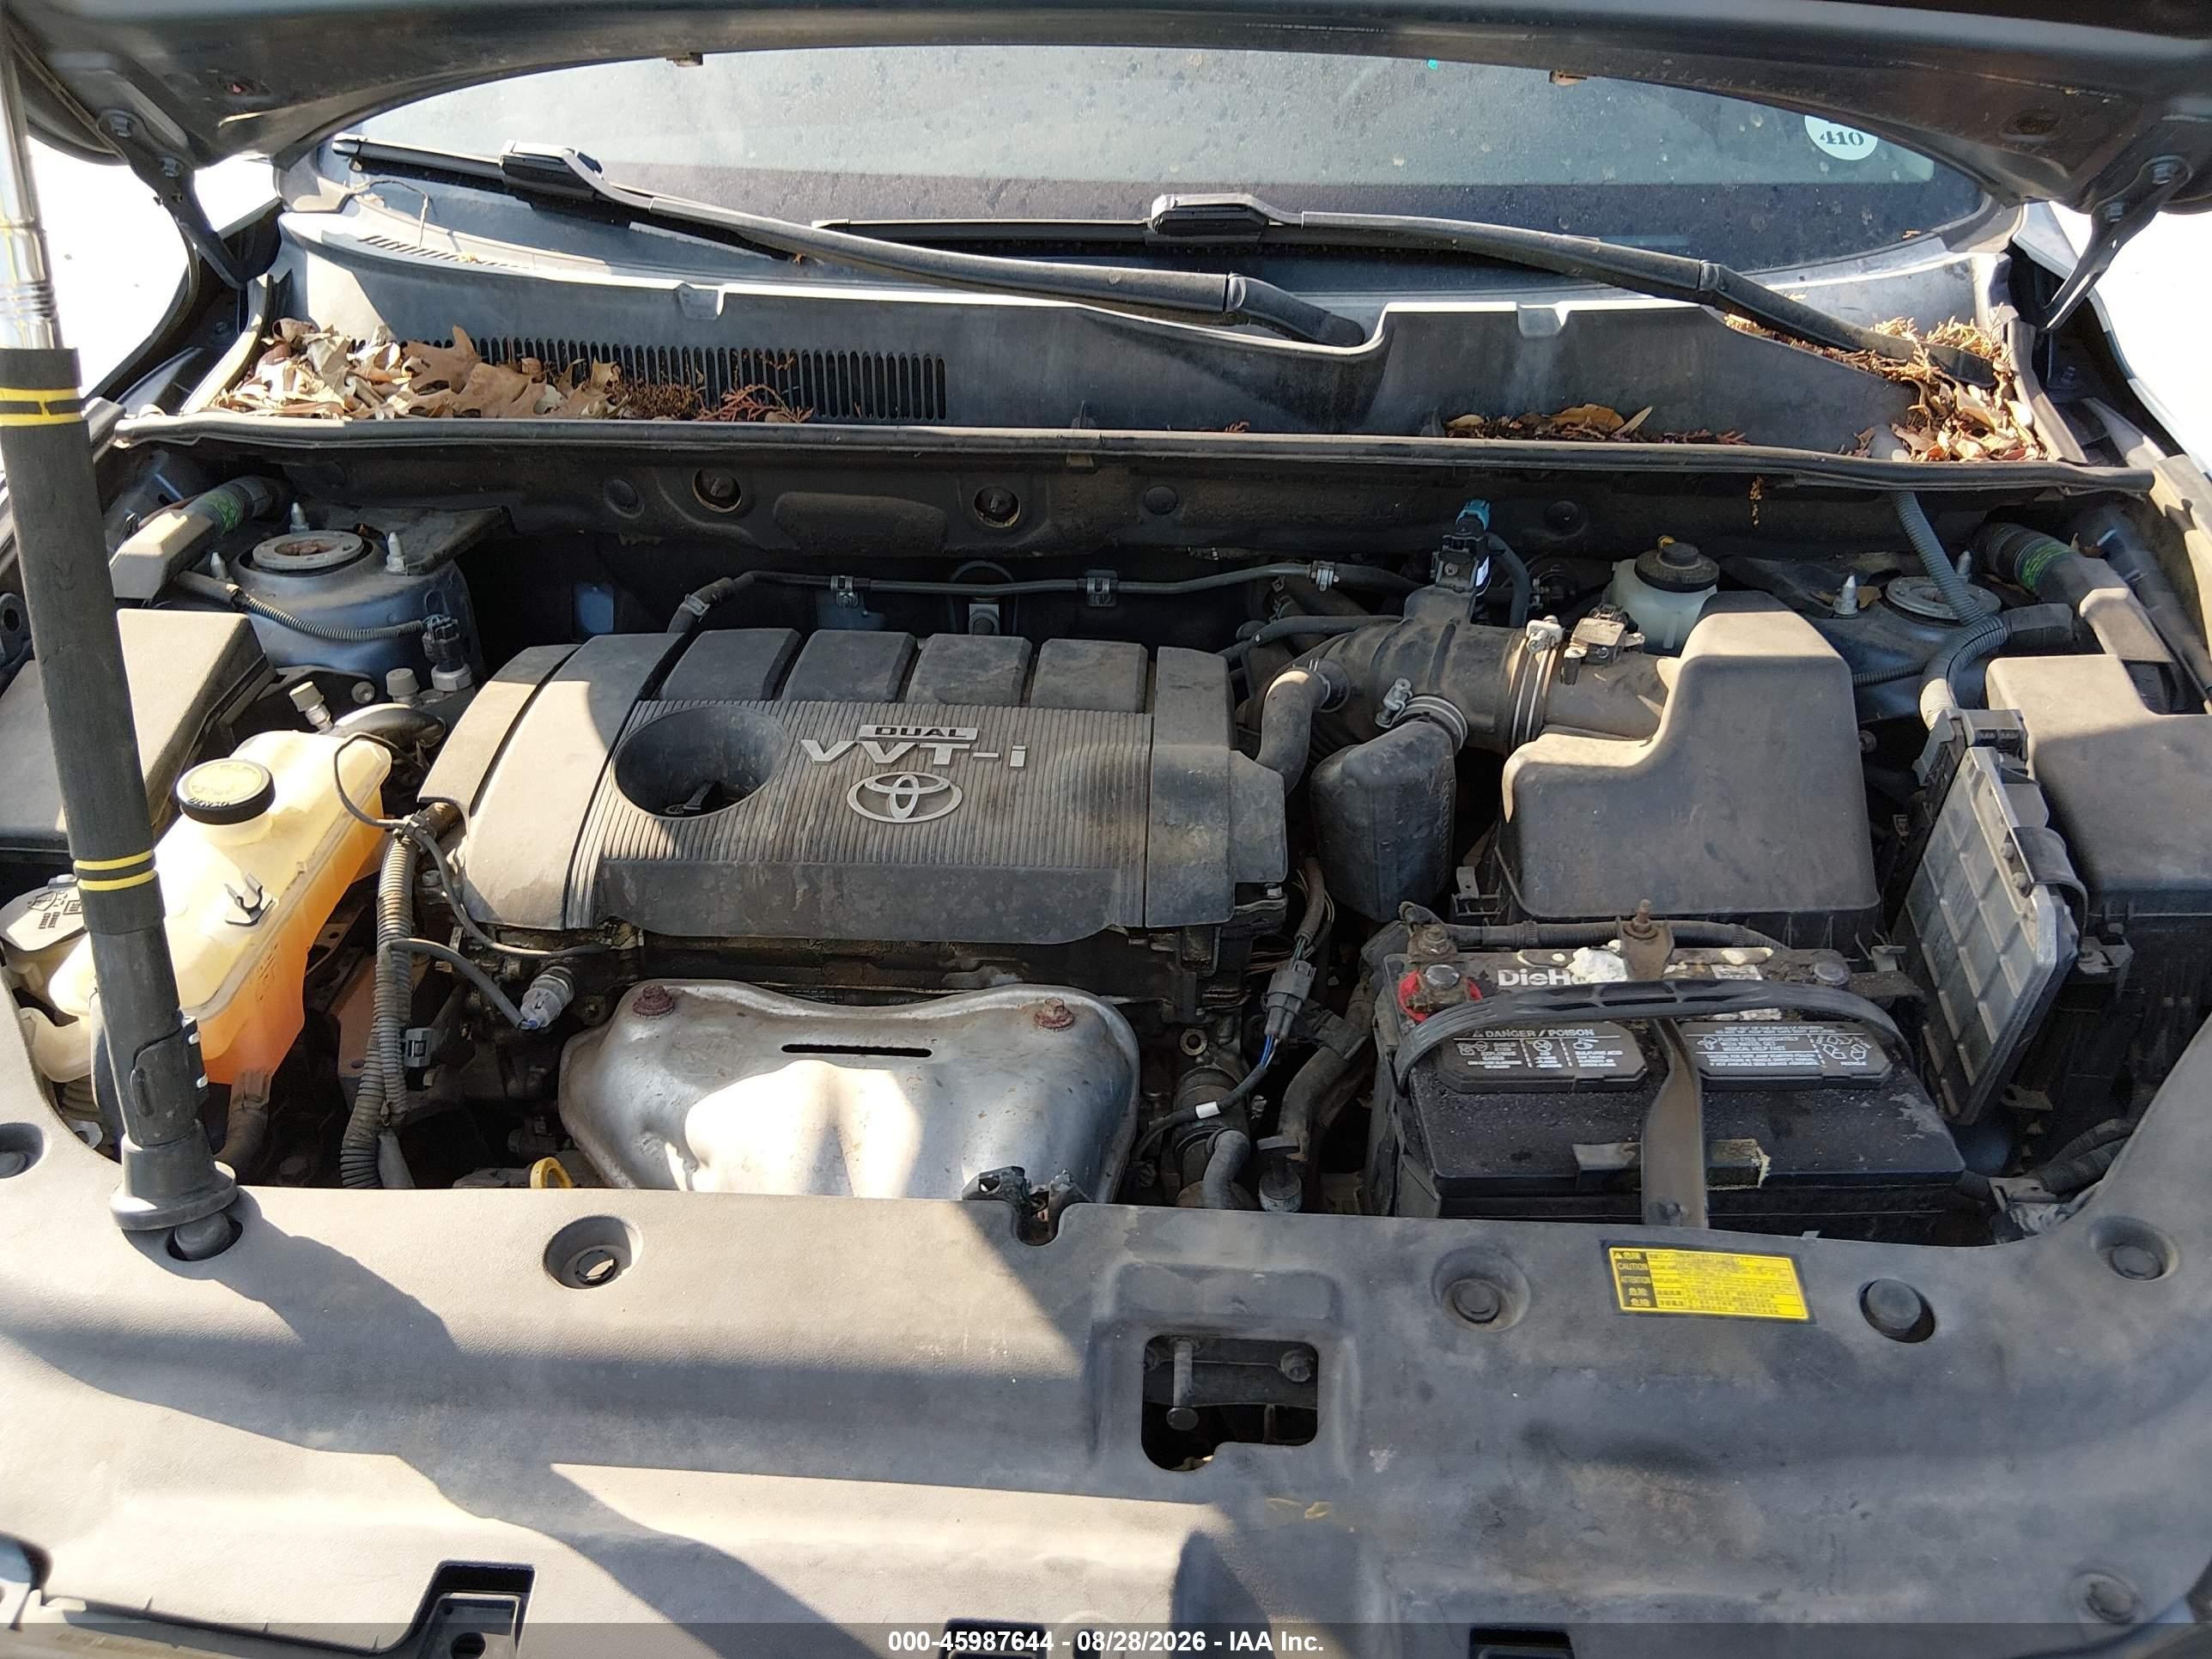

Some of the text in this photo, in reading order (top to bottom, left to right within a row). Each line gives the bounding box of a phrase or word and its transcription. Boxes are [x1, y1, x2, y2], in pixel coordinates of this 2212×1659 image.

[1820, 131, 1864, 146] 410
[874, 726, 969, 738] DUAL
[800, 738, 1028, 770] VVT-i
[1485, 1030, 1536, 1038] DANGER
[1547, 1029, 1595, 1037] POISON
[1617, 1262, 1649, 1272] CAUTION
